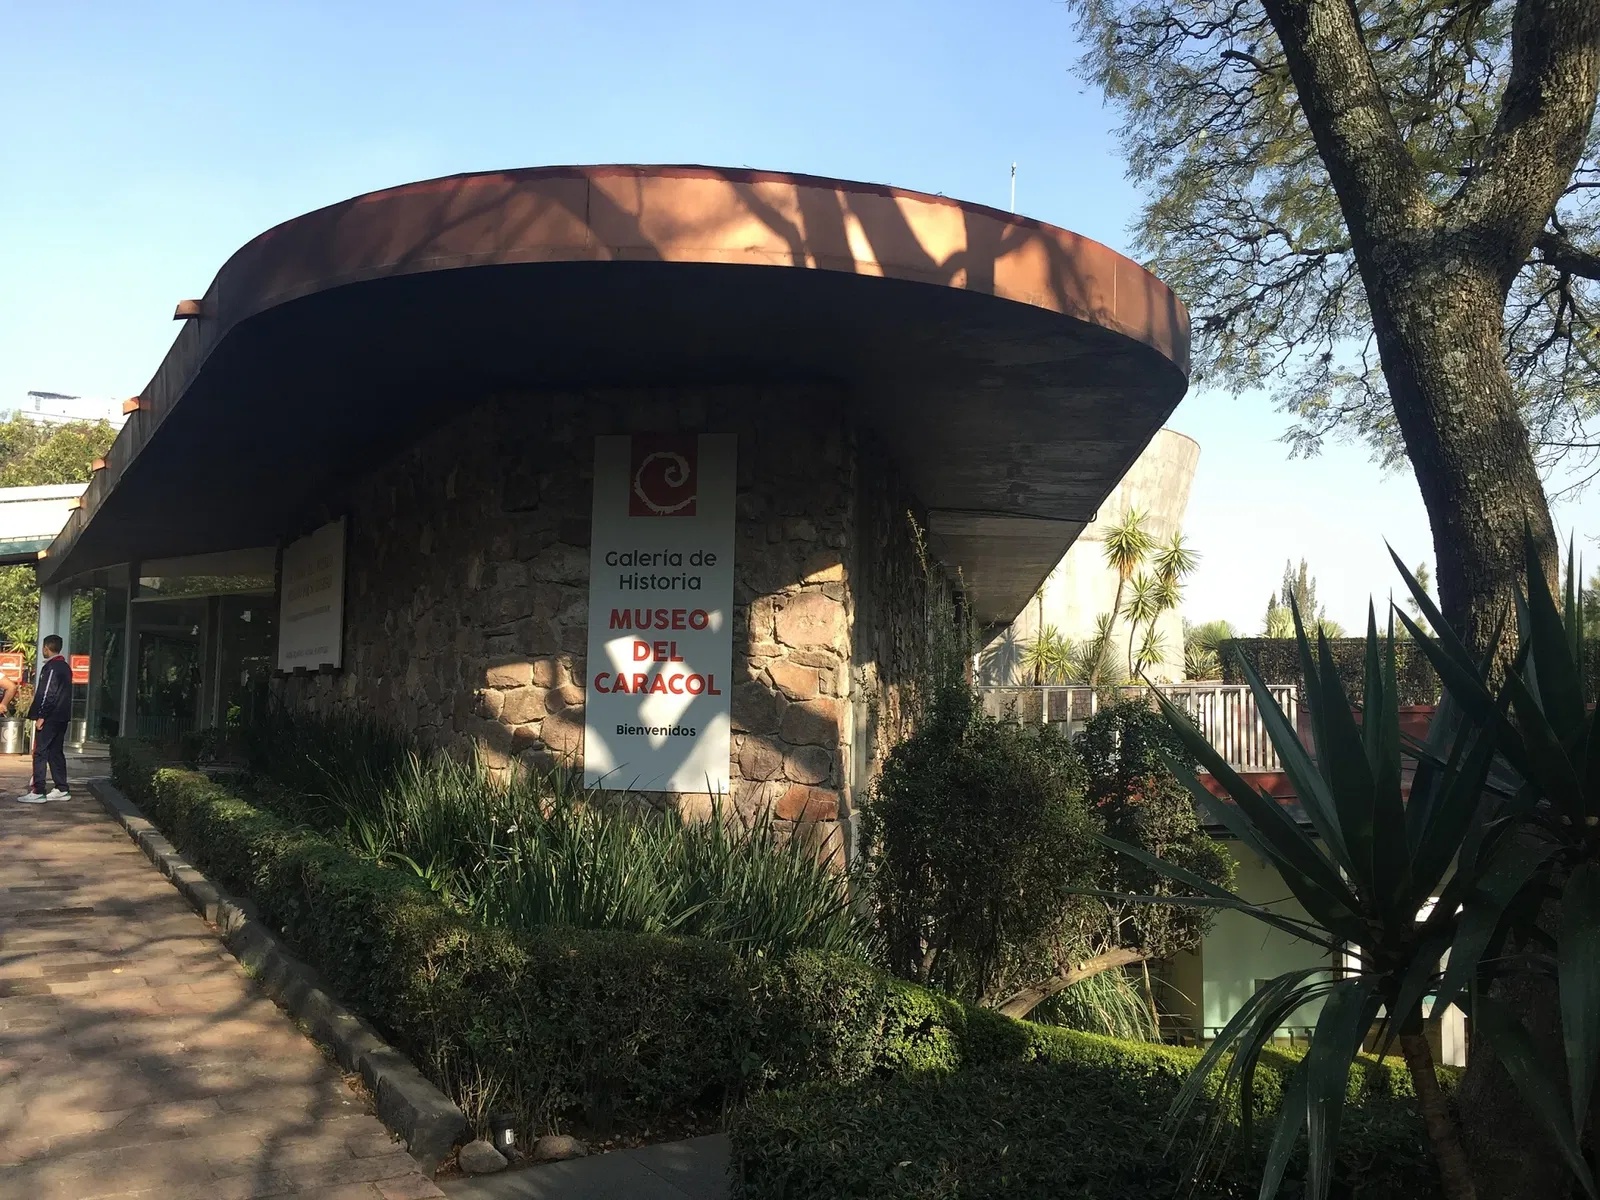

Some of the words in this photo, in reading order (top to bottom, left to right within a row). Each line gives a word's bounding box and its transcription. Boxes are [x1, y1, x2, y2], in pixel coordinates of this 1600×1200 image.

[605, 549, 683, 567] Galería
[690, 549, 717, 567] de
[620, 572, 702, 590] Historia
[609, 608, 709, 630] MUSEO
[633, 640, 684, 662] DEL
[594, 672, 721, 695] CARACOL
[616, 723, 696, 737] Bienvenidos
